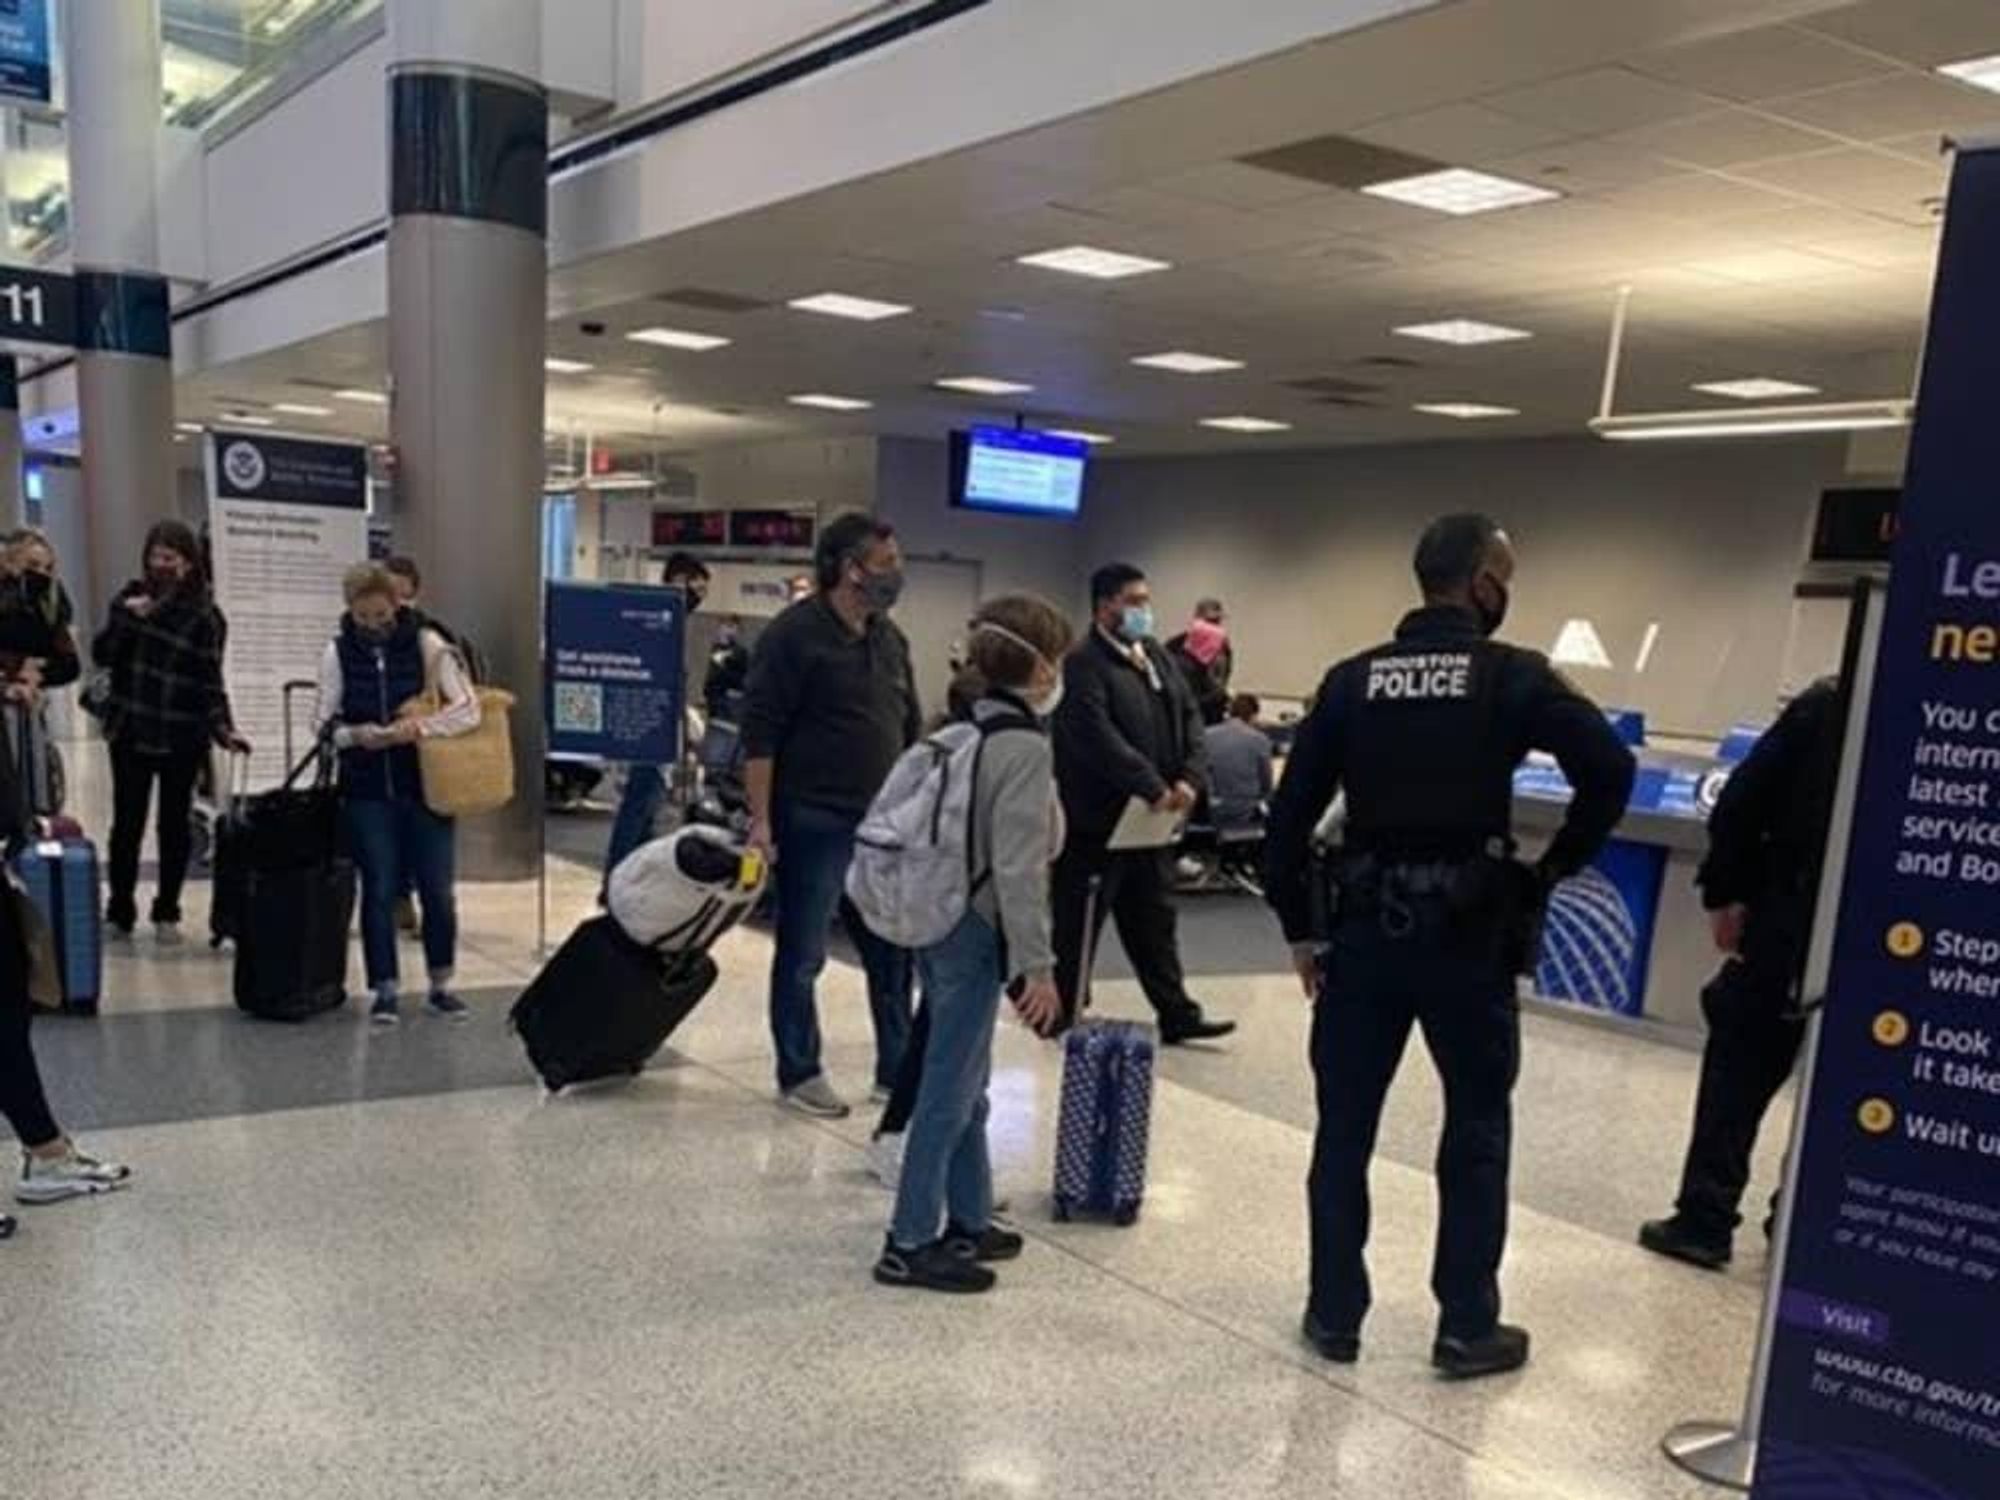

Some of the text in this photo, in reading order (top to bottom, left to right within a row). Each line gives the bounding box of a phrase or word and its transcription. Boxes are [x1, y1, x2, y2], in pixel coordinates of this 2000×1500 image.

[0, 283, 43, 326] 11
[1931, 622, 1997, 661] ne
[1370, 652, 1471, 673] HOUSTON
[1366, 668, 1468, 700] POLICE
[1921, 701, 1977, 731] You
[1907, 773, 1989, 808] latest
[1896, 850, 1951, 878] and
[1935, 927, 2000, 966] Step
[1920, 1020, 1991, 1057] Look
[1905, 1112, 1970, 1150] Wait
[1822, 1304, 1872, 1337] Visit
